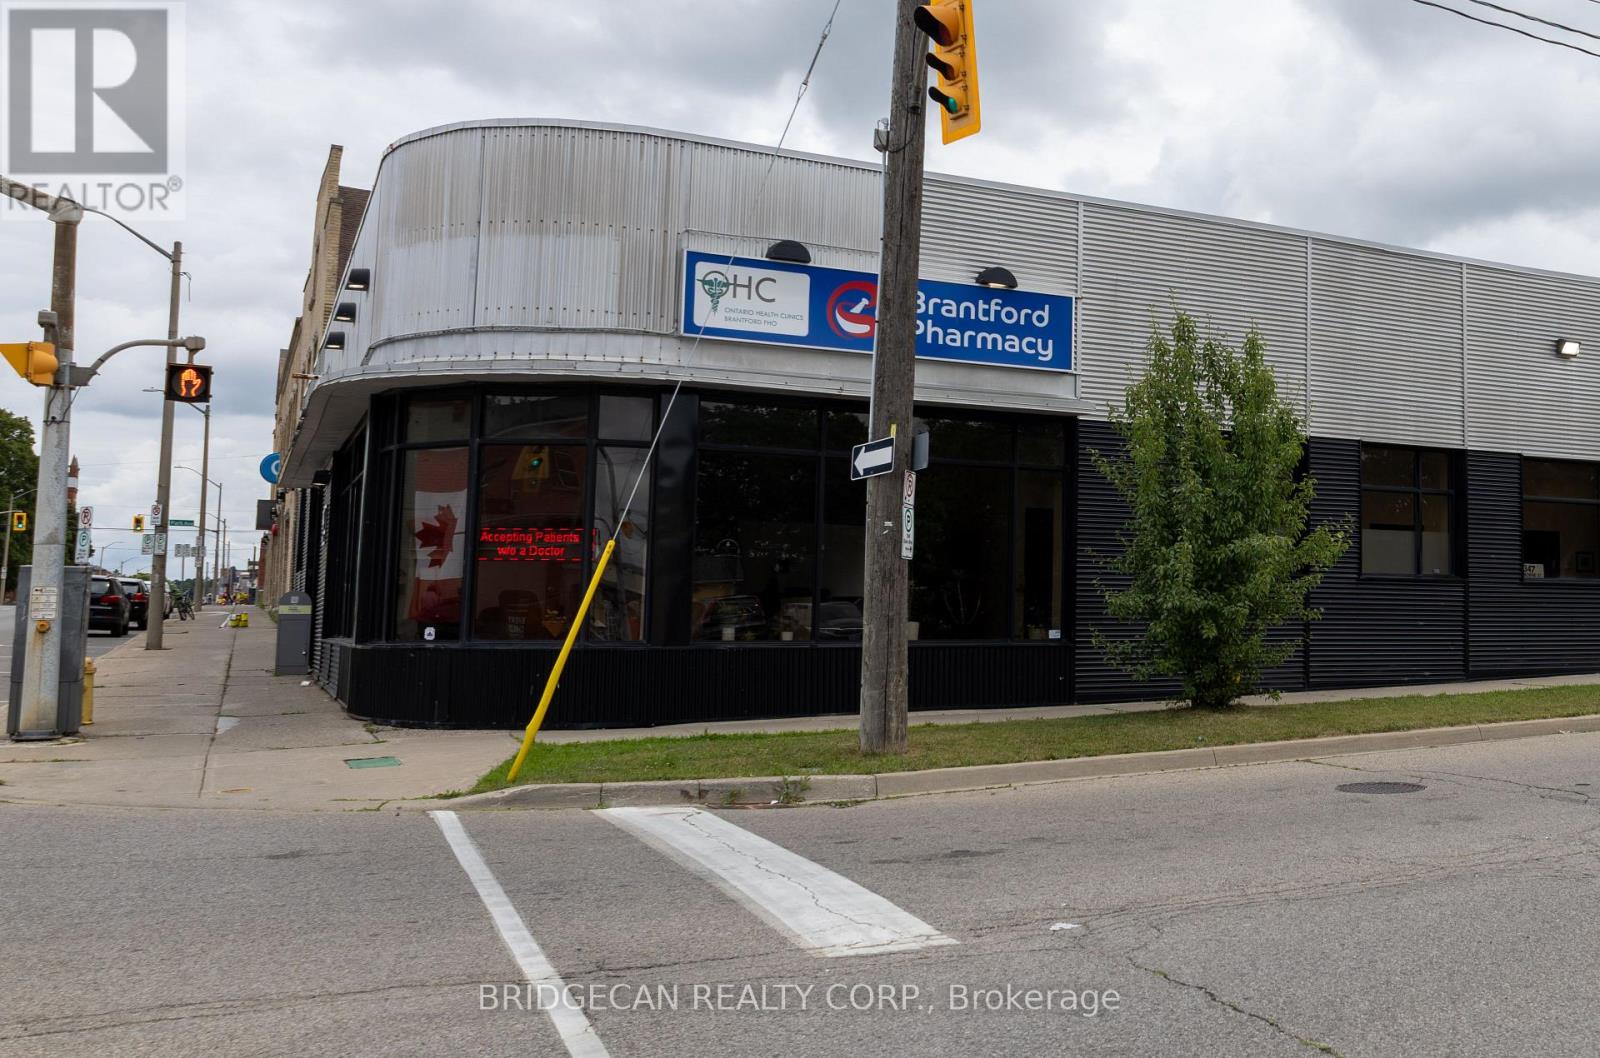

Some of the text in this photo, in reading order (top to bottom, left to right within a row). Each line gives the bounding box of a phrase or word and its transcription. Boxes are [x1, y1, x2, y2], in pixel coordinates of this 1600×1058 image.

[724, 306, 804, 321] ONTARIO HEALTH CLINICS
[916, 290, 1050, 328] Brantford
[724, 315, 762, 325] BRANTFORD
[915, 319, 1054, 362] Pharmacy
[480, 531, 581, 545] Accepting Patients
[519, 546, 527, 556] a
[528, 545, 566, 556] Doctor
